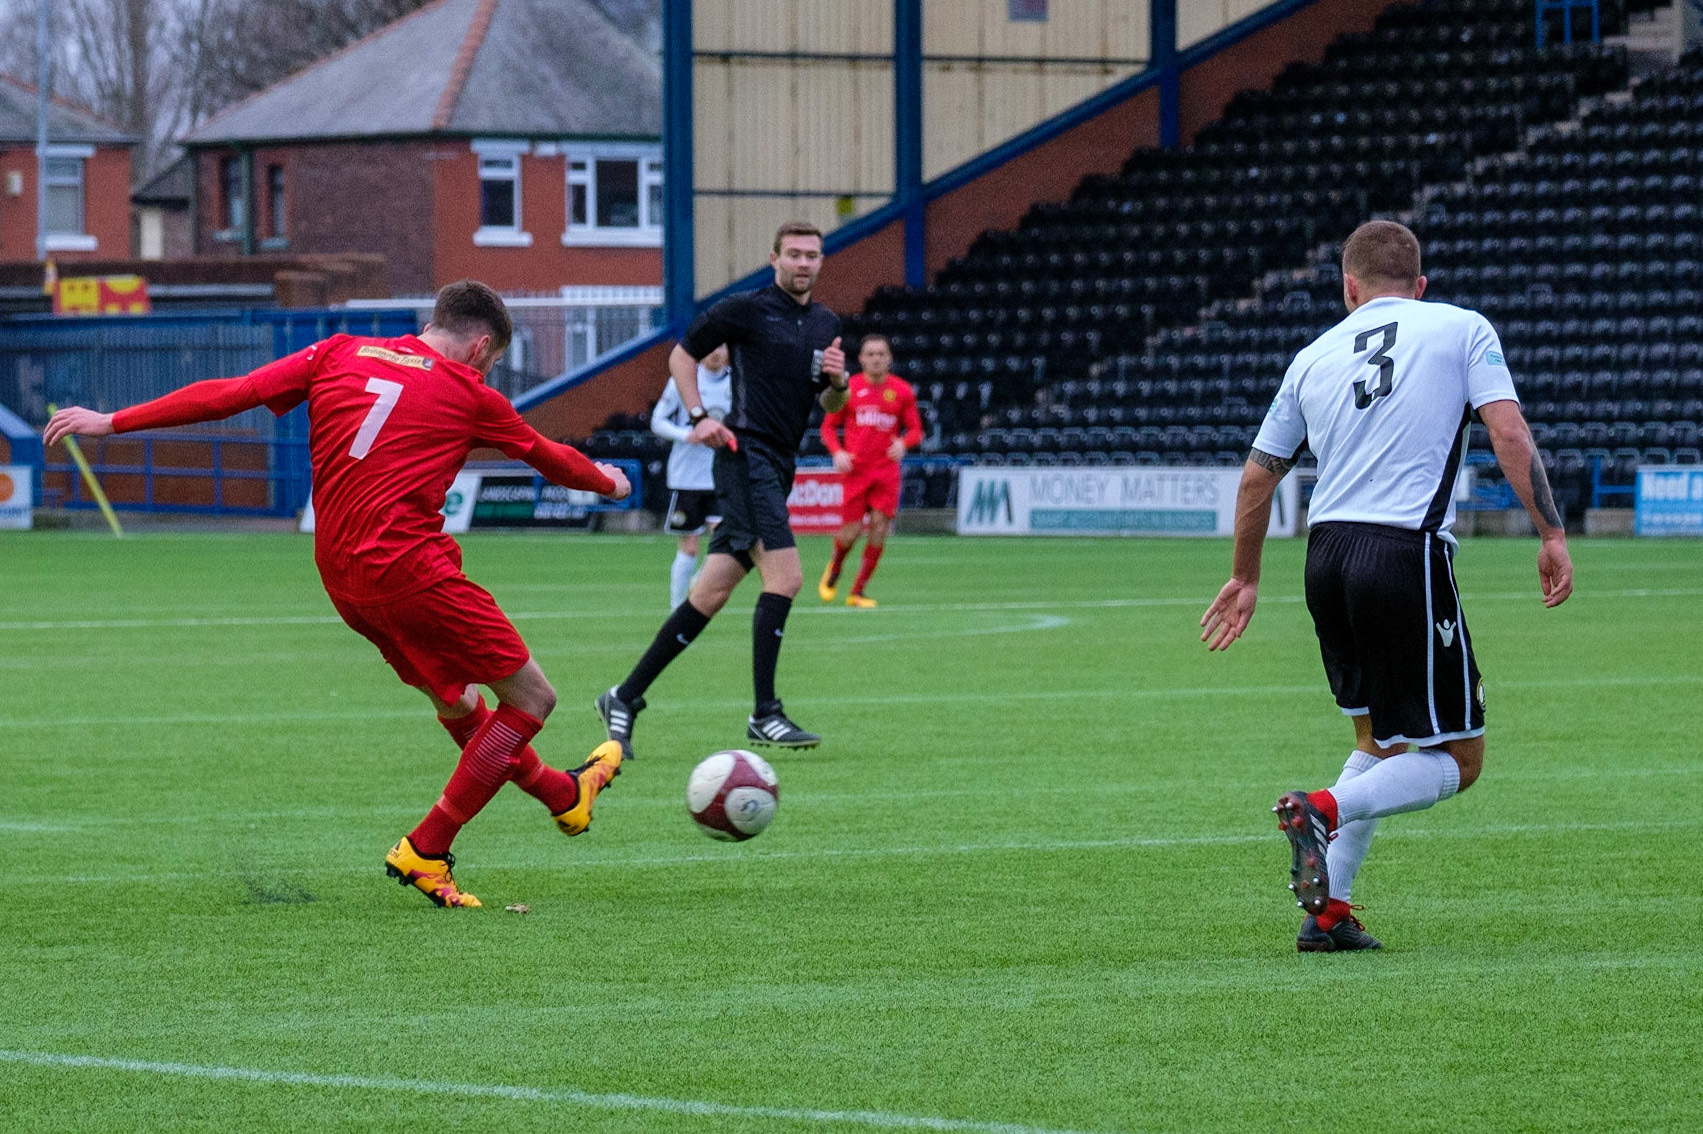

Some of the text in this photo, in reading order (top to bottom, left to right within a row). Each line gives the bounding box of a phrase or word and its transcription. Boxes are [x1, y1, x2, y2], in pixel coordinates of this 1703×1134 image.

[1353, 321, 1399, 410] 3
[348, 376, 404, 460] 7
[1029, 474, 1220, 504] MONEY MATTERS
